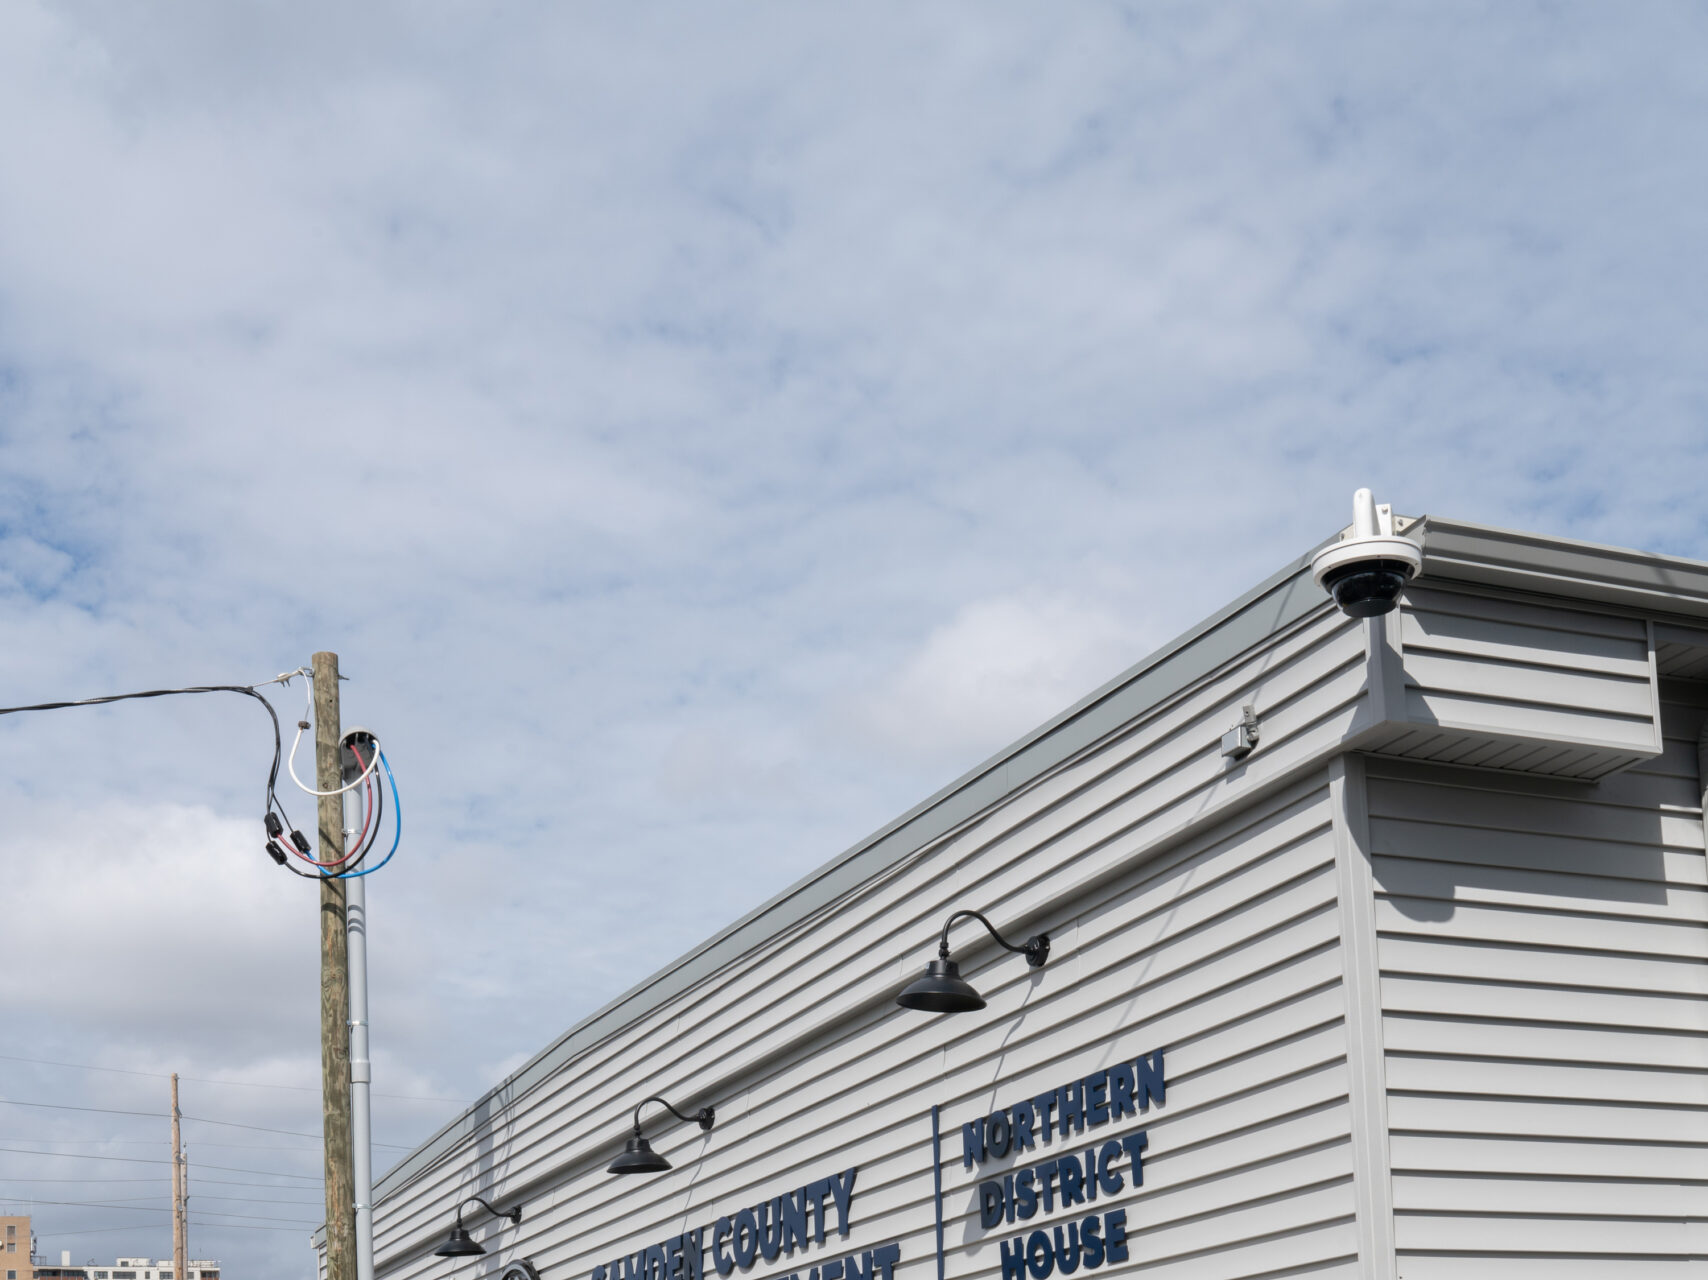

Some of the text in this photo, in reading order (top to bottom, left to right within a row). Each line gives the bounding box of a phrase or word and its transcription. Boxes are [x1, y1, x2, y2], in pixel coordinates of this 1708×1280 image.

[962, 1049, 1167, 1168] NORTHERN
[712, 1167, 857, 1277] COUNTY
[979, 1130, 1149, 1230] DISTRICT
